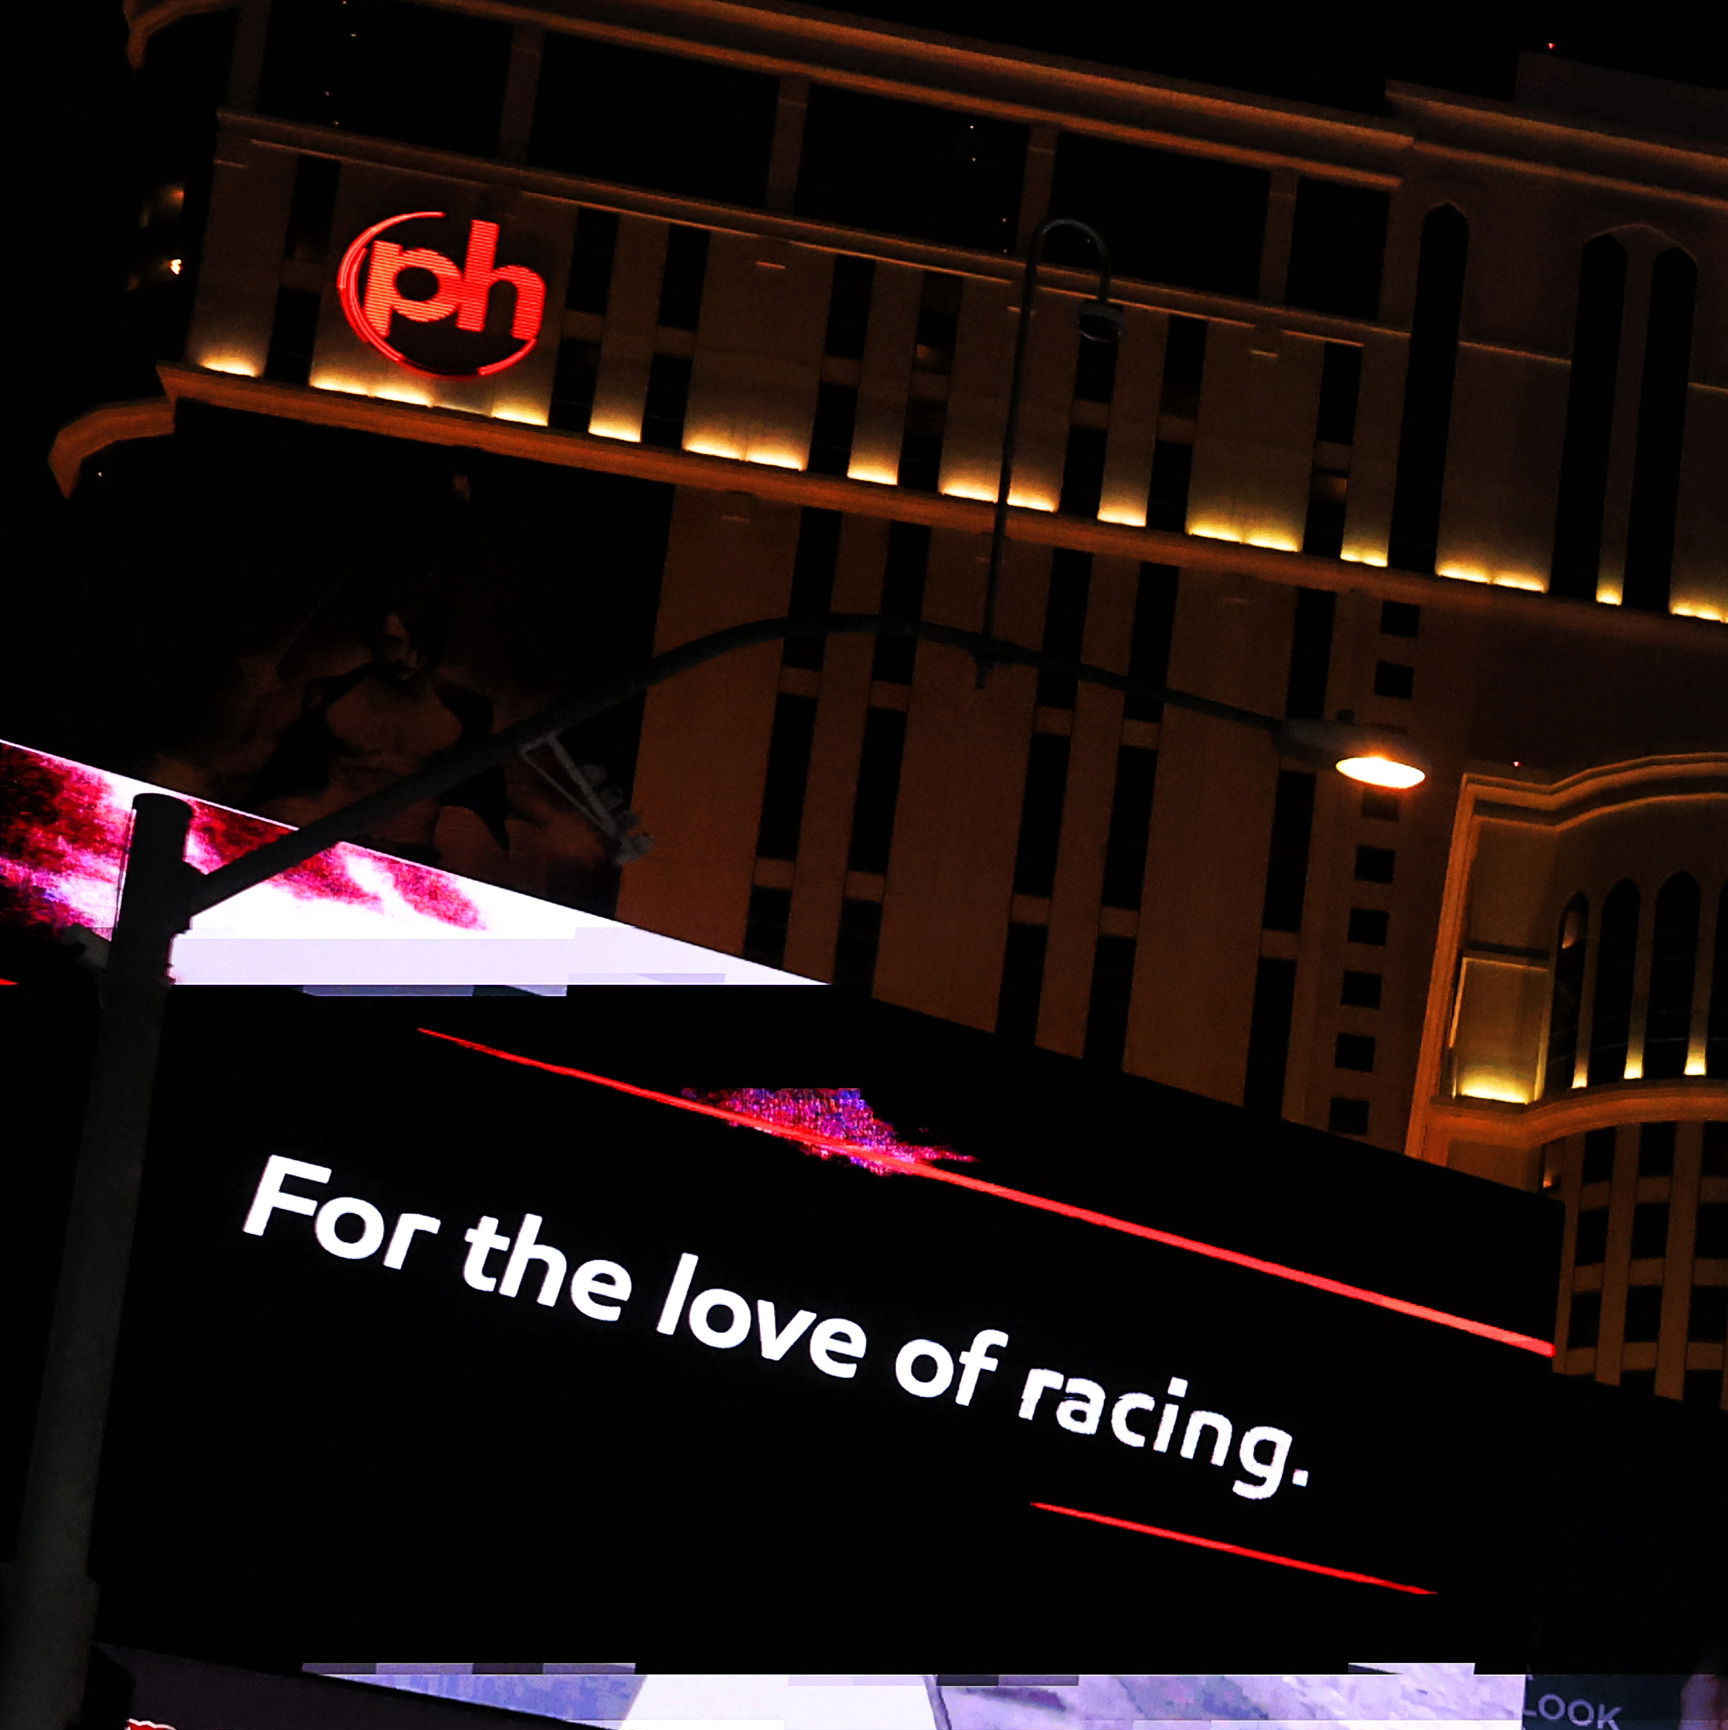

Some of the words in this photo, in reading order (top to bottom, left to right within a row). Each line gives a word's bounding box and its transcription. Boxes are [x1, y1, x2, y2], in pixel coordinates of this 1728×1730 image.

[364, 219, 547, 339] ph
[242, 1154, 437, 1270] For
[461, 1214, 632, 1322] the
[656, 1253, 868, 1378] love
[894, 1329, 1008, 1406] of
[1017, 1377, 1309, 1500] racing.
